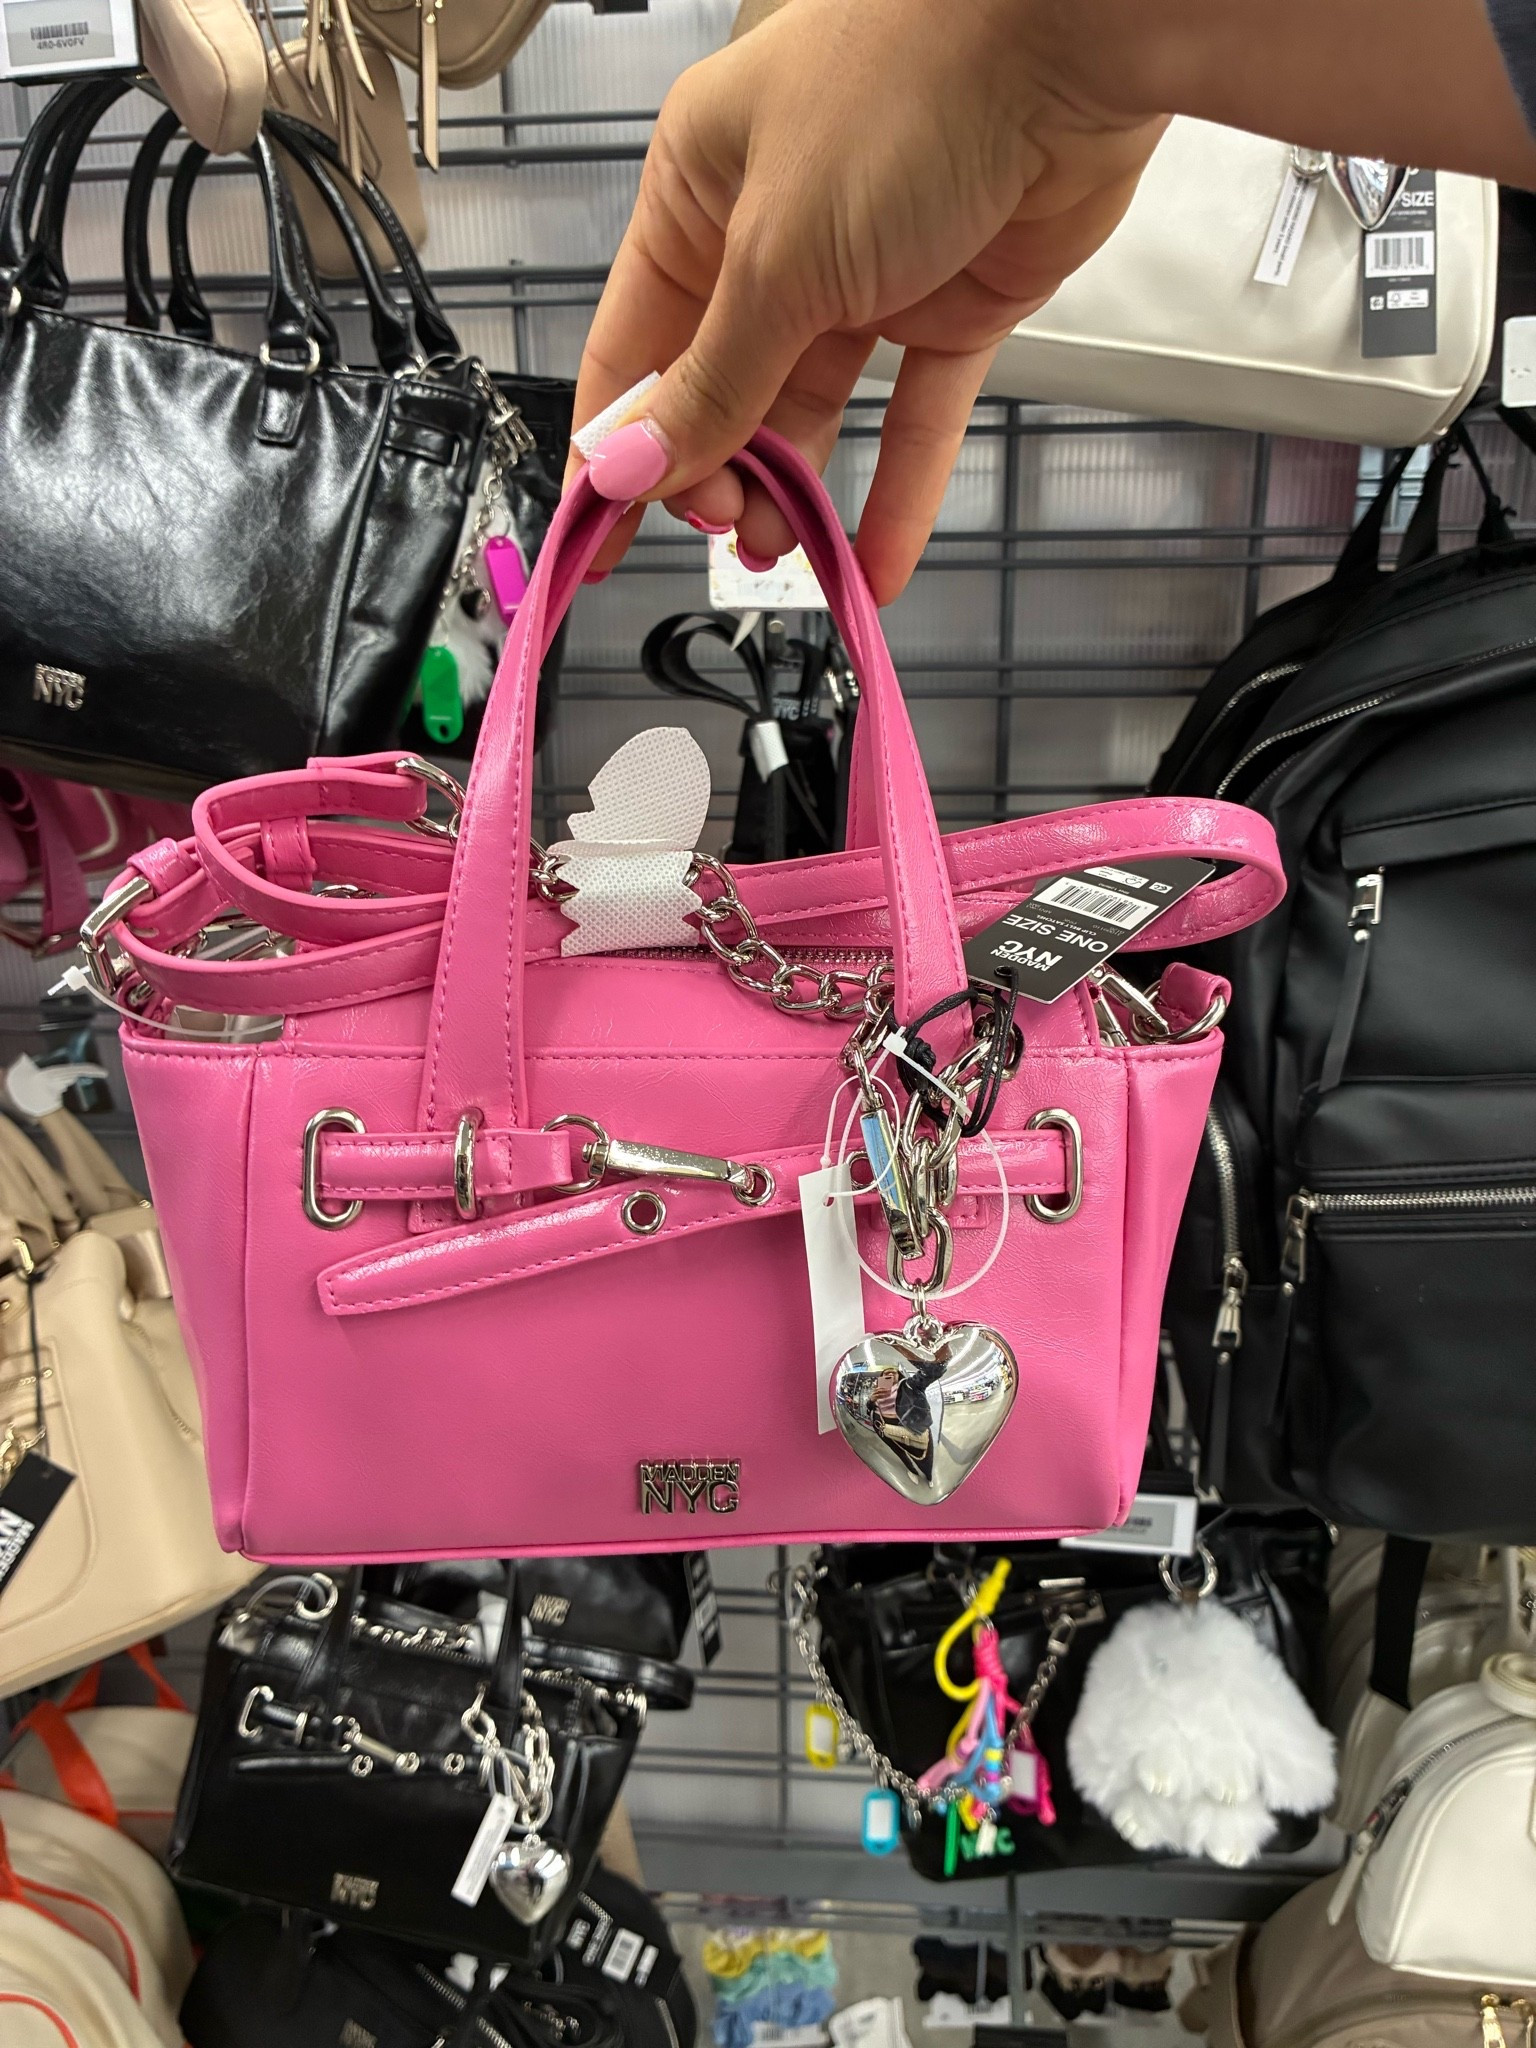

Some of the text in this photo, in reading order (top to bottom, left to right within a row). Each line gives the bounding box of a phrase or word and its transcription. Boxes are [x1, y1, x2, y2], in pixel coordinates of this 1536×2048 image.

[1401, 190, 1434, 208] SIZE
[1002, 914, 1056, 935] SIZE
[1055, 929, 1109, 952] ONE
[990, 949, 1051, 972] MADDEN
[999, 940, 1063, 967] NYC
[640, 1461, 740, 1481] MADDEN
[642, 1480, 739, 1514] NYC
